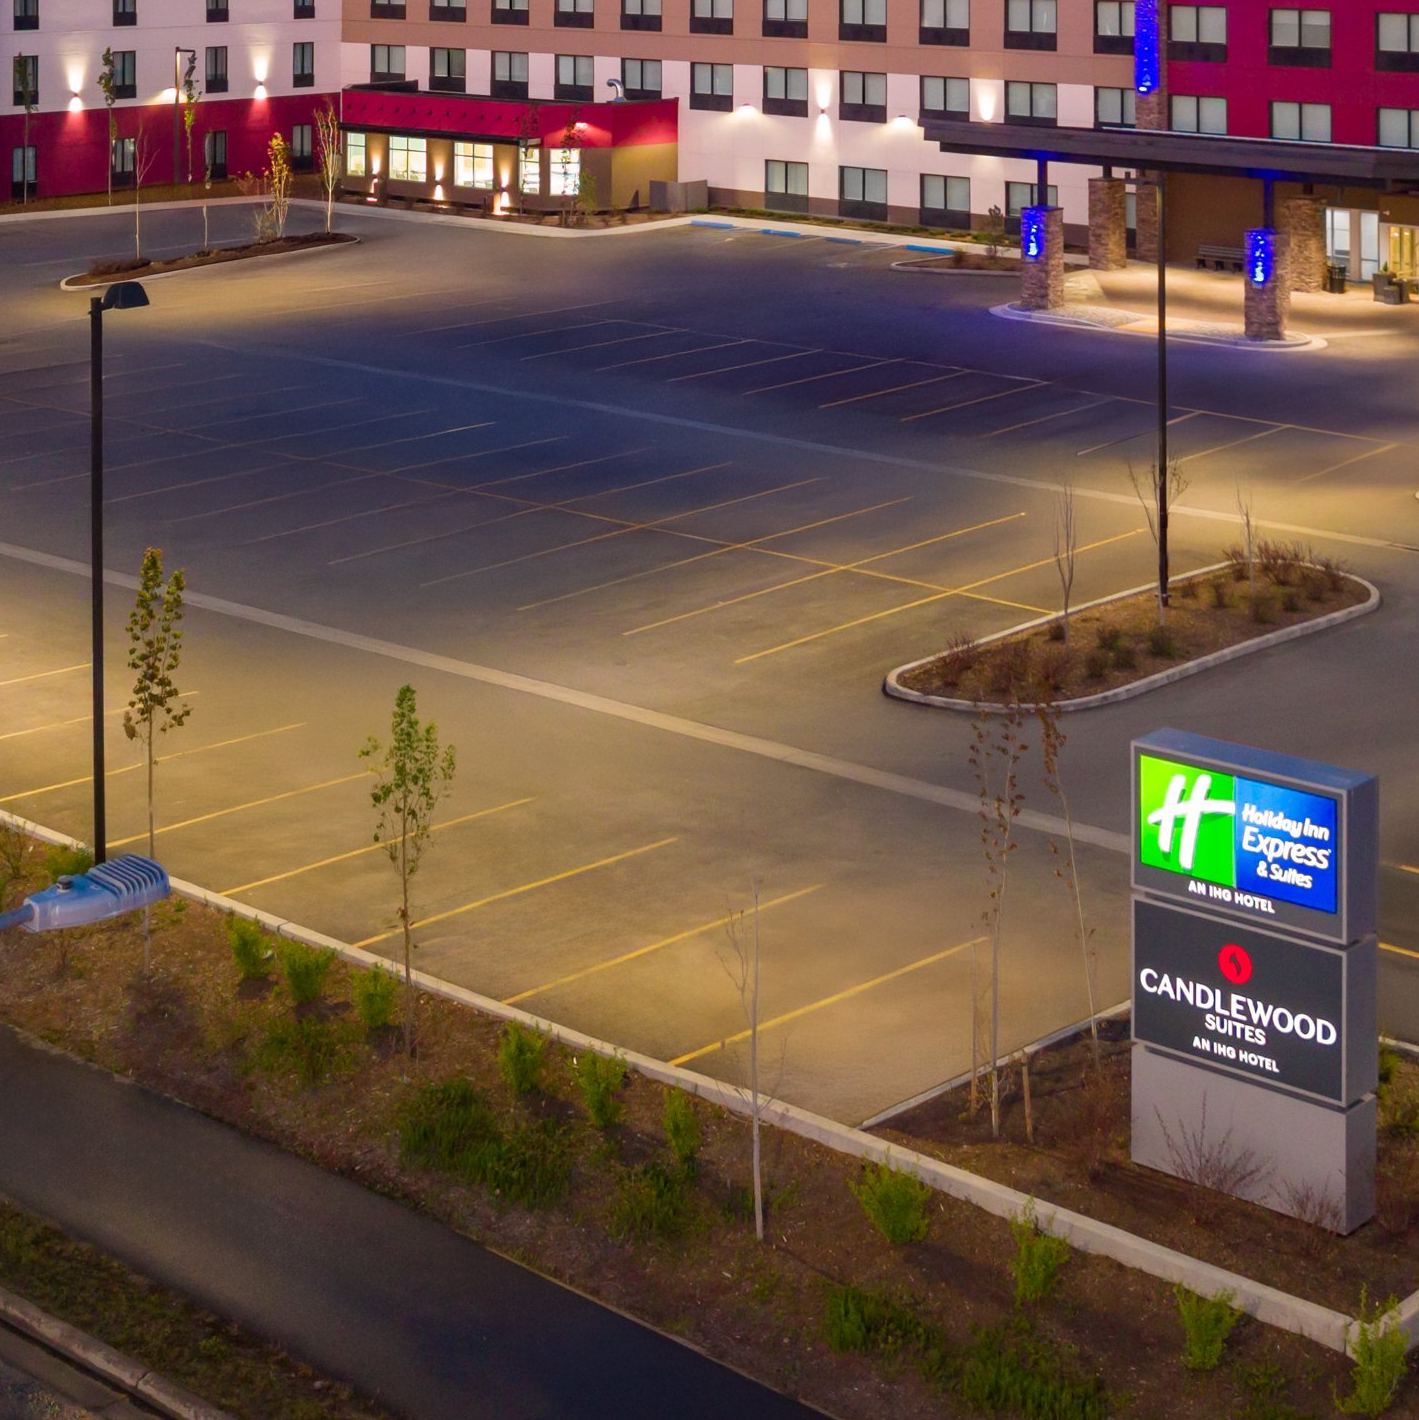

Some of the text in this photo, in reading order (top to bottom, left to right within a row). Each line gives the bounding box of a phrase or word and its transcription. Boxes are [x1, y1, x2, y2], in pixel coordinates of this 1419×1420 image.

[1241, 803, 1330, 841] Holiday Inn
[1241, 825, 1330, 870] Express
[1256, 860, 1313, 889] & Suites
[1188, 880, 1275, 914] AN IHG HOTEL
[1139, 967, 1337, 1045] CANDLEWOOD
[1204, 1013, 1267, 1046] SUITES
[1192, 1035, 1280, 1073] AN IHG HOTEL
